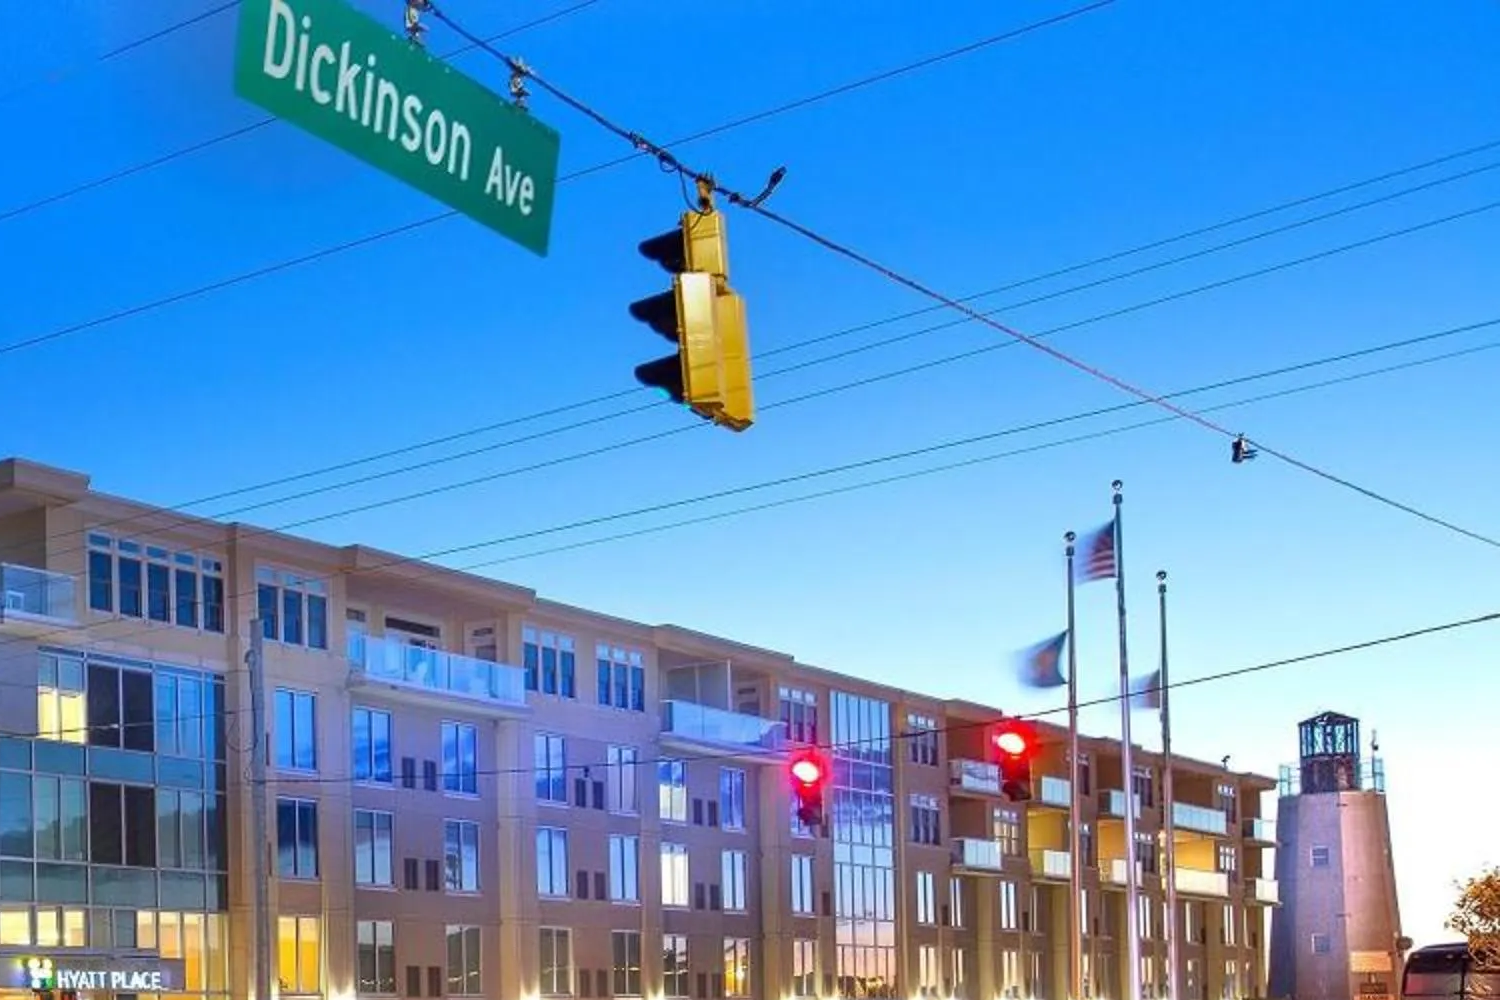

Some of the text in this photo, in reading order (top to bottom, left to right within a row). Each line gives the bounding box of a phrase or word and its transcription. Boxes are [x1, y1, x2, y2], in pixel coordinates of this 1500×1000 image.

[263, 0, 535, 216] Dickinson Ave
[57, 970, 161, 989] HYATT PLACE
